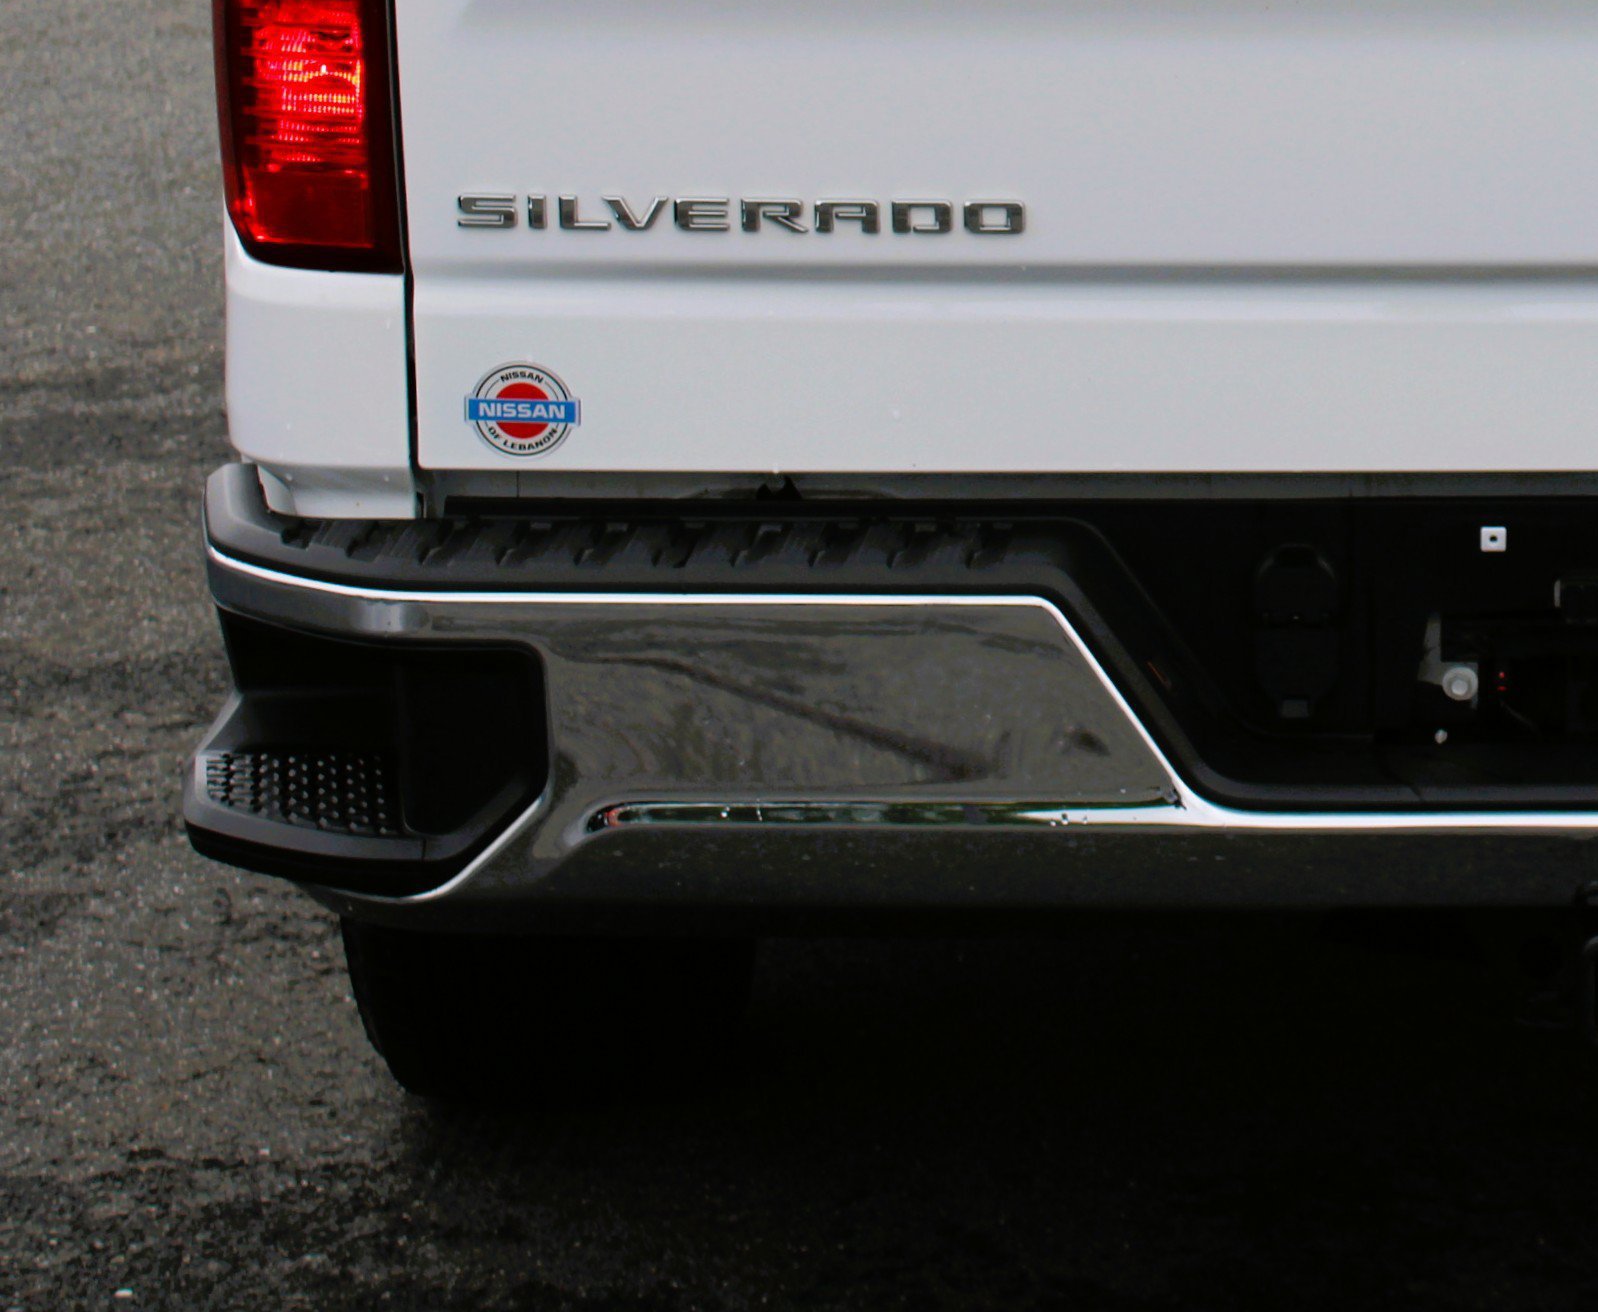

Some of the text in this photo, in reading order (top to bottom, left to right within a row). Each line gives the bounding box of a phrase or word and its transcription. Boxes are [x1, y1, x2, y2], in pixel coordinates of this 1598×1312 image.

[457, 192, 1026, 236] SILVERADO
[500, 370, 544, 383] NISSAN
[478, 402, 566, 419] NISSAN
[487, 426, 558, 451] OF LEBANON
